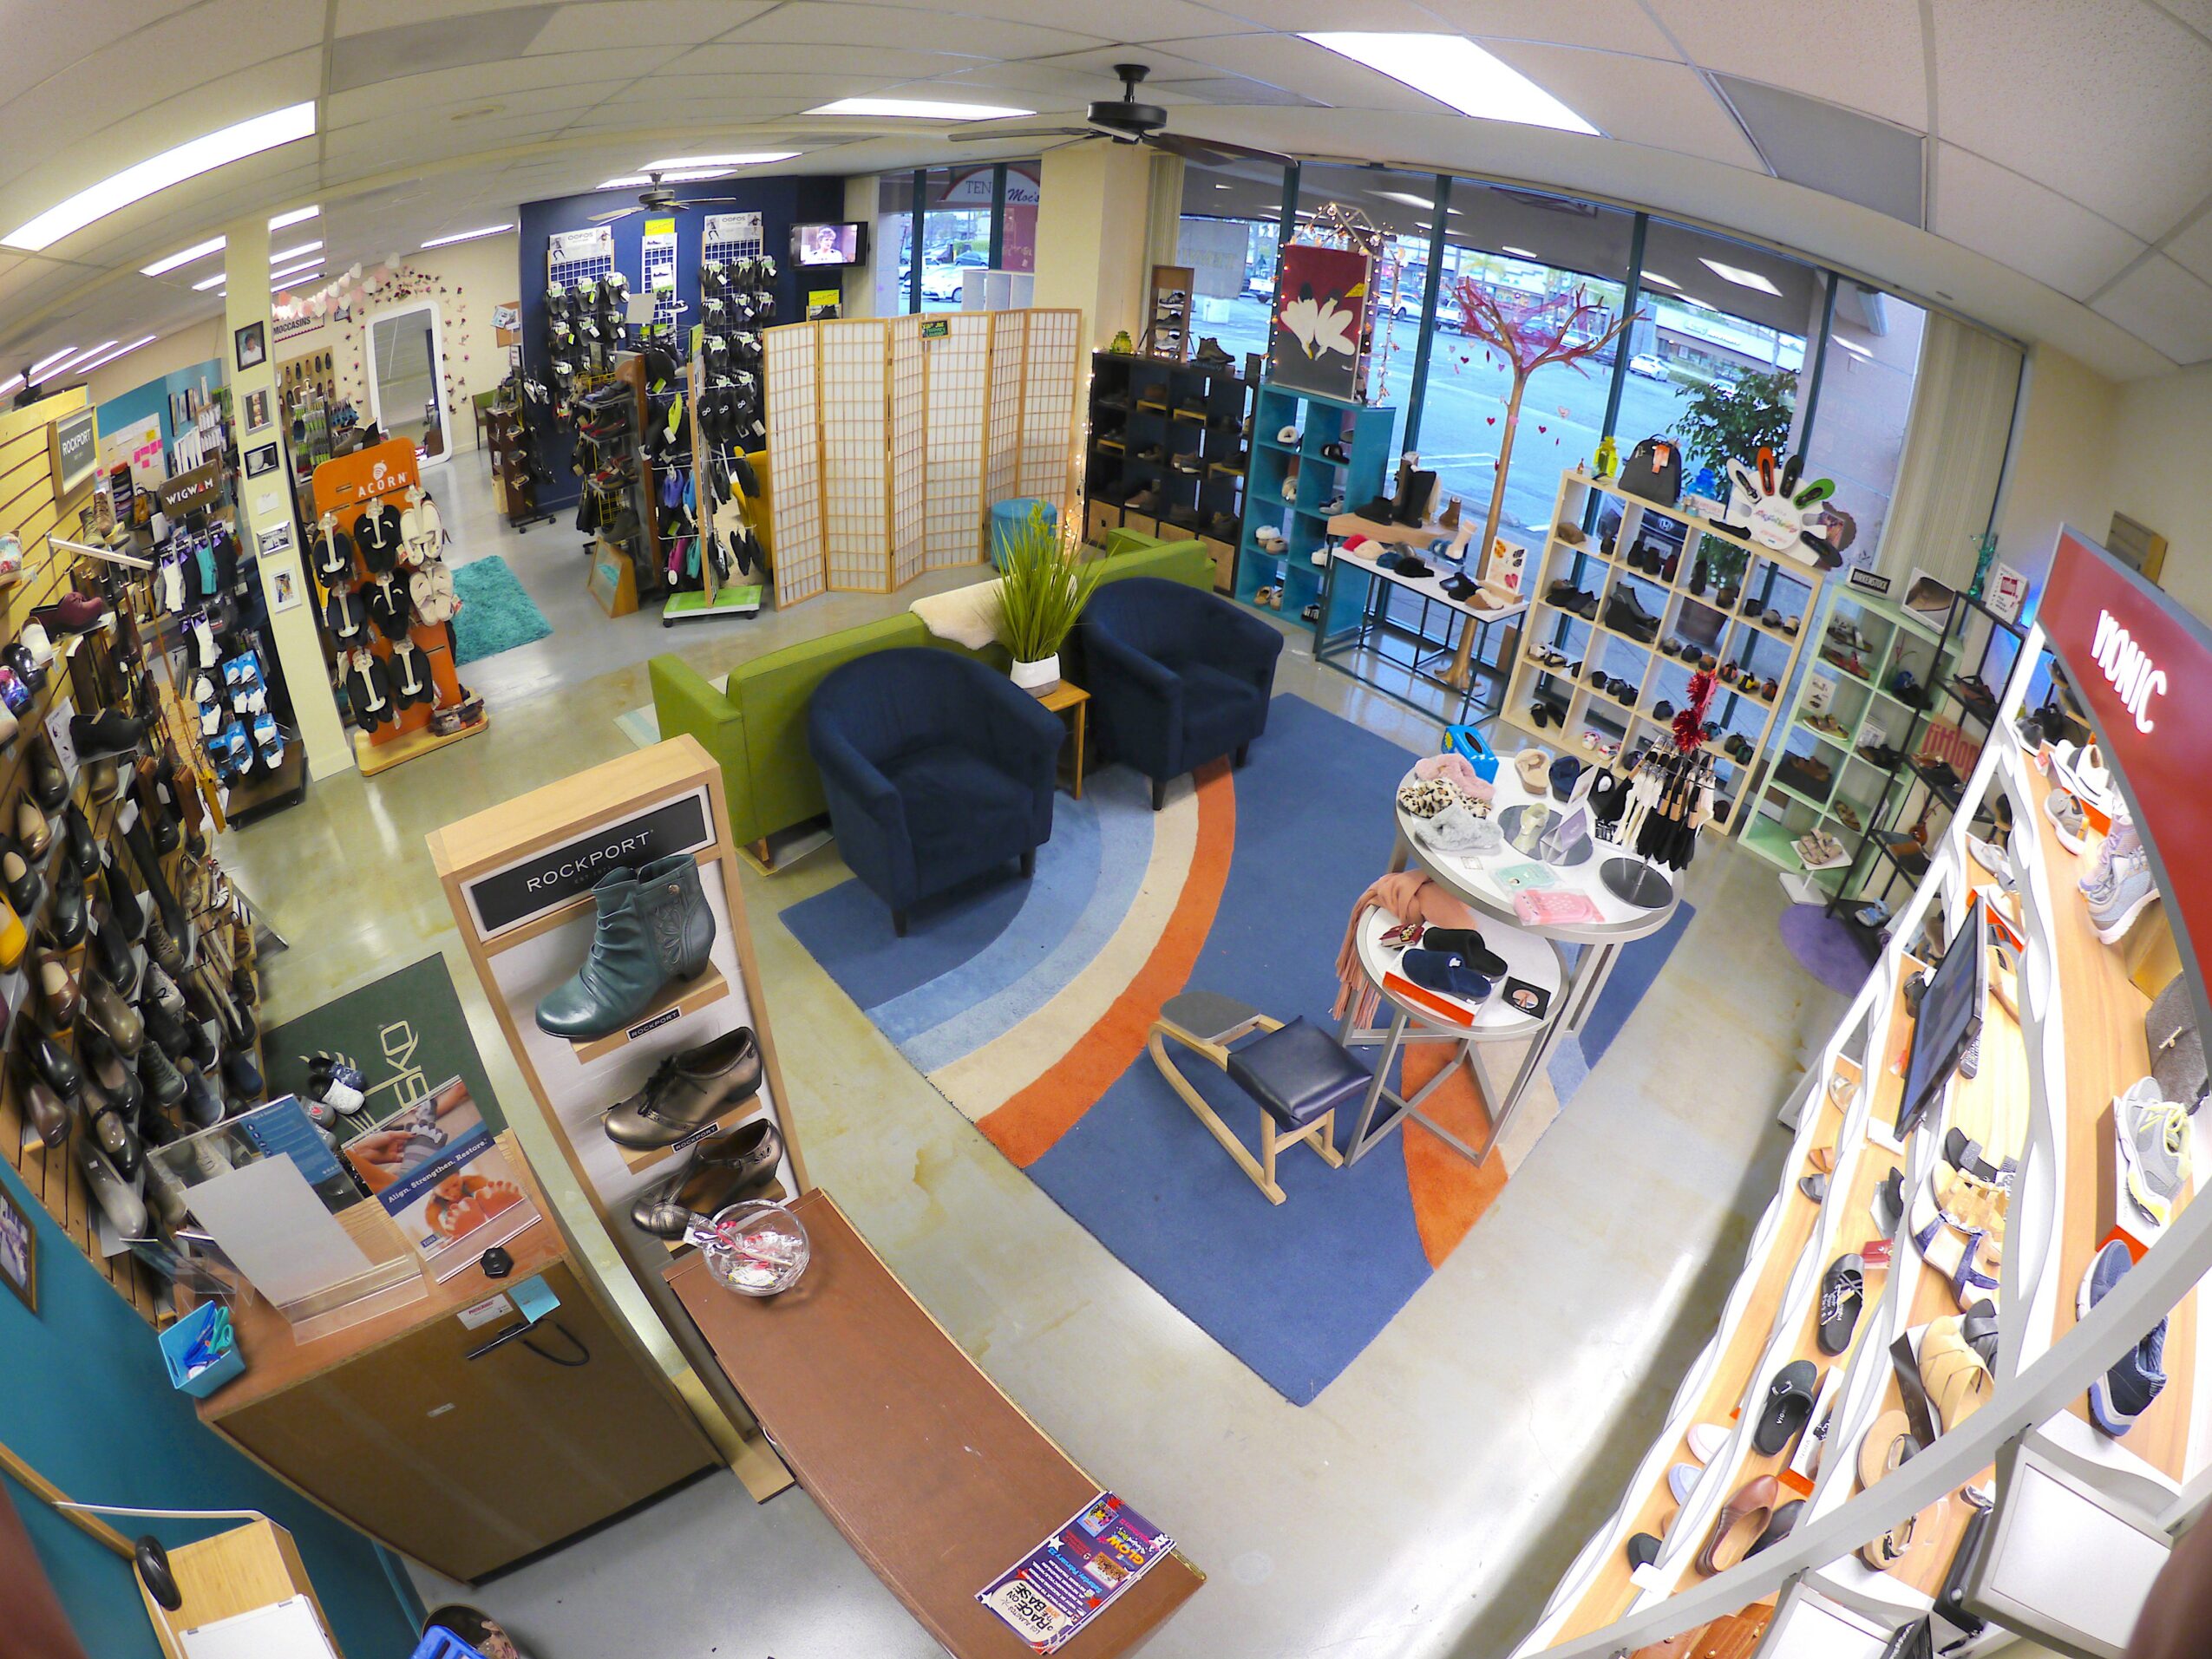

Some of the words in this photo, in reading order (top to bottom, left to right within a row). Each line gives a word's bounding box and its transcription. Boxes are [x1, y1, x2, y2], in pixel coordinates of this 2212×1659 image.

[272, 317, 311, 335] MOCCASINS
[62, 428, 91, 457] ROCKPORT
[358, 473, 407, 498] ACORN
[526, 831, 651, 893] ROCKPORT
[630, 1011, 678, 1038] ROCKPORT
[675, 1126, 717, 1152] ROCKPORT
[388, 1187, 412, 1204] Align.
[410, 1160, 456, 1189] Strengthen.
[1055, 1553, 1079, 1575] February
[1106, 1536, 1145, 1566] GLOW
[1077, 1571, 1103, 1594] Saturday,
[1005, 1590, 1019, 1603] ON
[1013, 1582, 1046, 1612] BASE
[1013, 1599, 1050, 1630] RACE
[1040, 1610, 1052, 1623] THE
